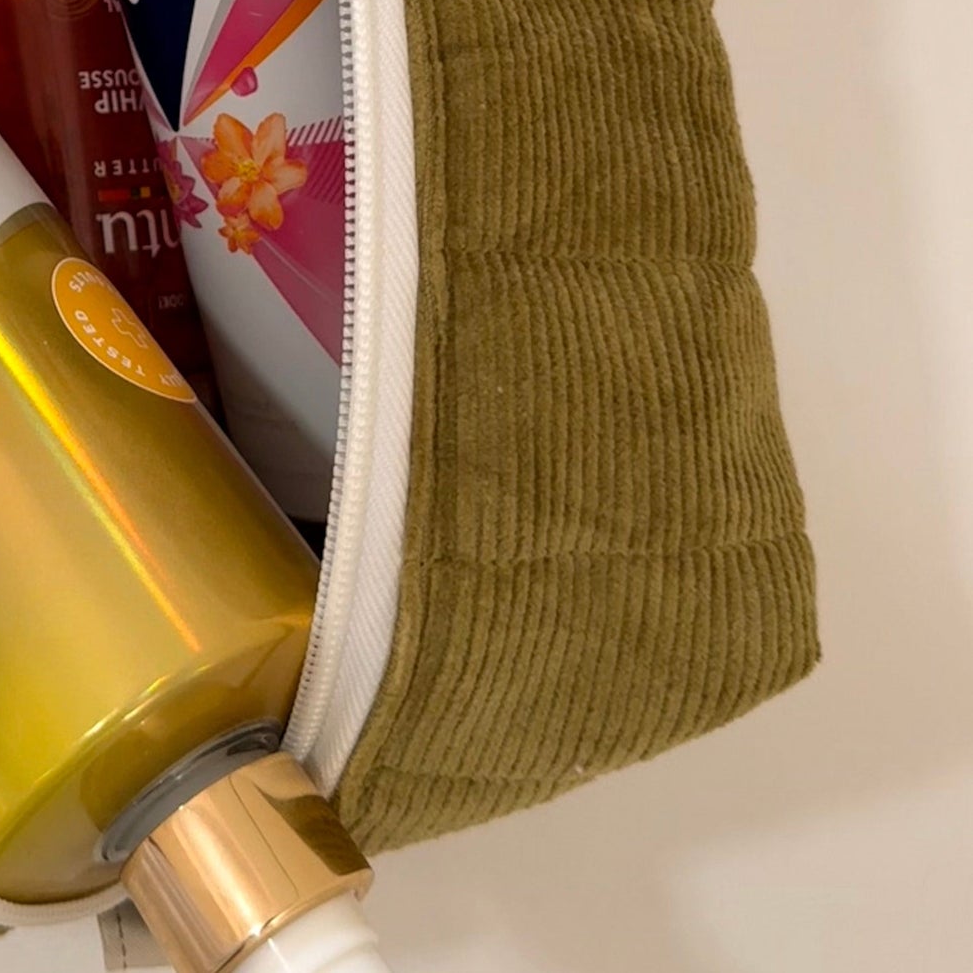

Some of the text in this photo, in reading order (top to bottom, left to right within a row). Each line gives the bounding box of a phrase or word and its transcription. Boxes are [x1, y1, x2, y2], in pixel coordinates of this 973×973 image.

[78, 68, 140, 89] OUSSE
[93, 89, 146, 114] HIP
[94, 158, 160, 177] UTTER
[74, 309, 146, 376] TESTED
